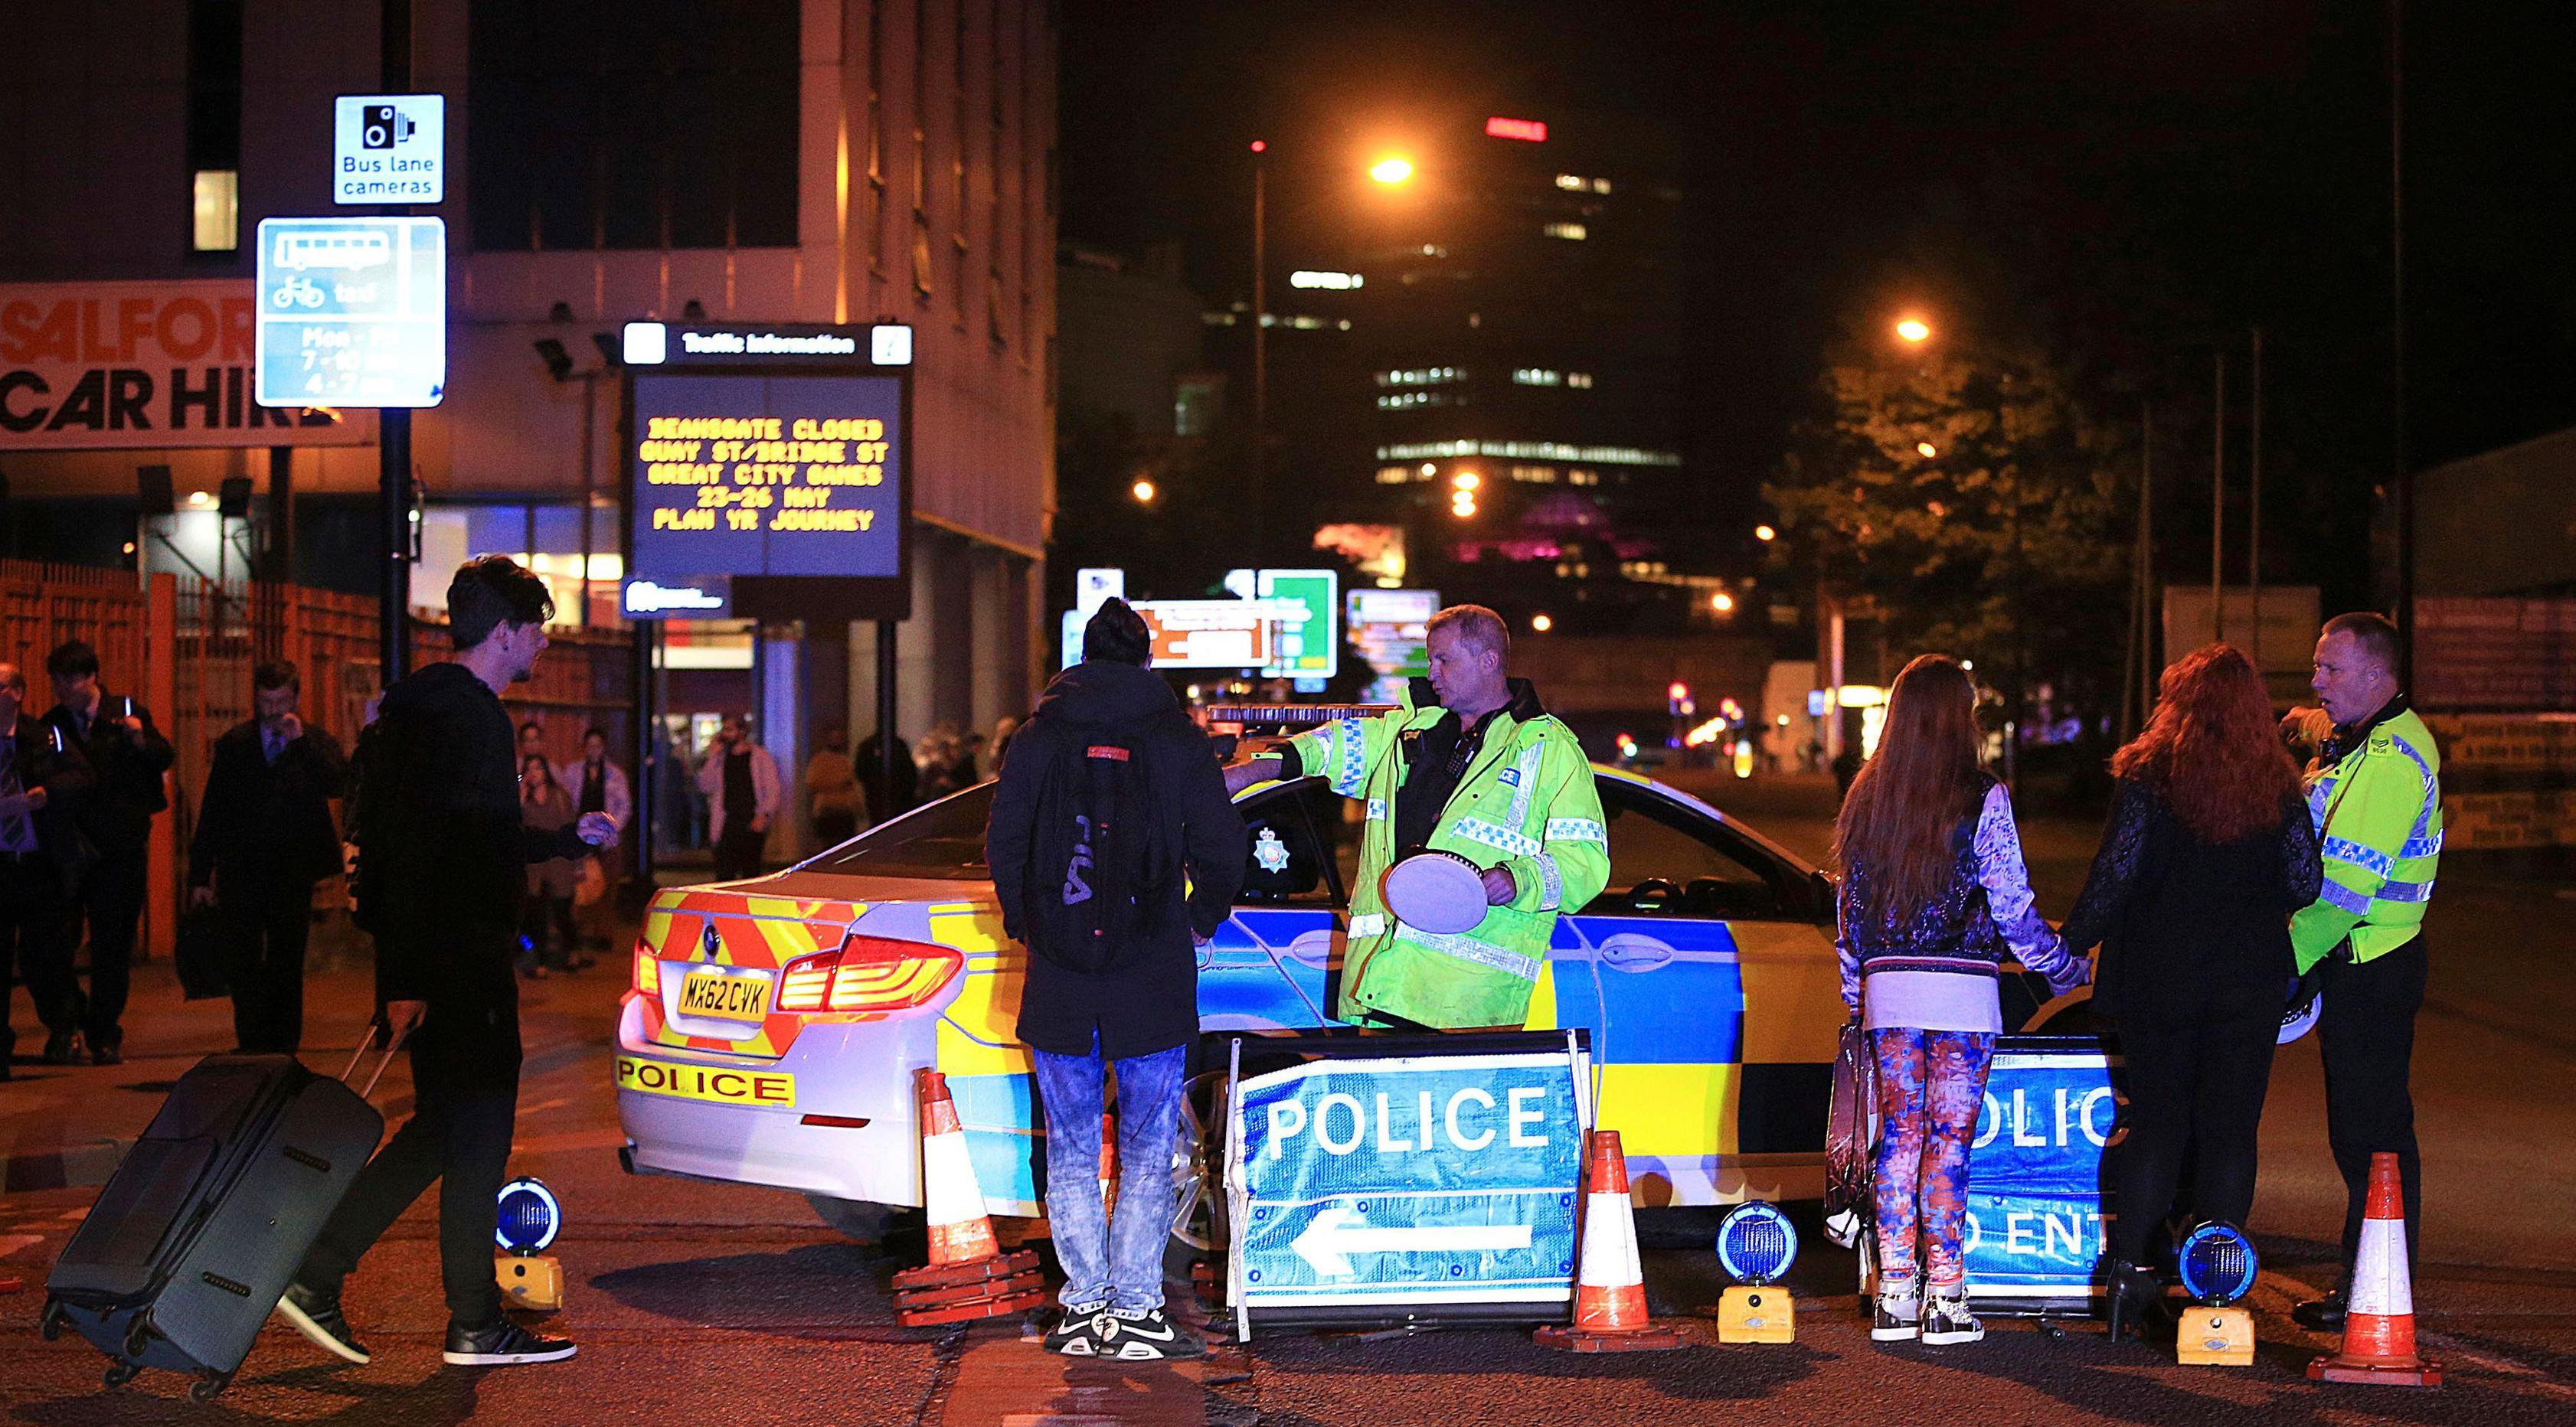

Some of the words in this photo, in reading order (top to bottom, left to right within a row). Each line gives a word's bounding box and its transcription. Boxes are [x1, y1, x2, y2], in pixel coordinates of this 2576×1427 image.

[344, 156, 381, 172] Bus
[391, 156, 434, 171] lane
[344, 181, 432, 195] cameras
[2, 298, 256, 364] SALFOR
[302, 326, 351, 348] Mon
[682, 332, 744, 354] Traffic
[0, 369, 152, 433] CAR
[648, 417, 782, 439] DEANSGATE
[793, 418, 883, 441] CLOSED
[639, 440, 701, 462] QUAY
[712, 441, 846, 463] ST/BRIDGE
[856, 442, 889, 463] ST
[647, 463, 724, 485] GREAT
[734, 463, 796, 485] CITY
[806, 464, 883, 486] GAMES
[697, 485, 773, 508] 23-26
[783, 486, 831, 508] MAY
[653, 508, 715, 530] PLAN
[726, 508, 759, 531] YR
[769, 509, 874, 531] JOURNEY
[685, 978, 727, 1011] MX62
[728, 982, 764, 1014] CVK
[1267, 1086, 1549, 1161] POLICE
